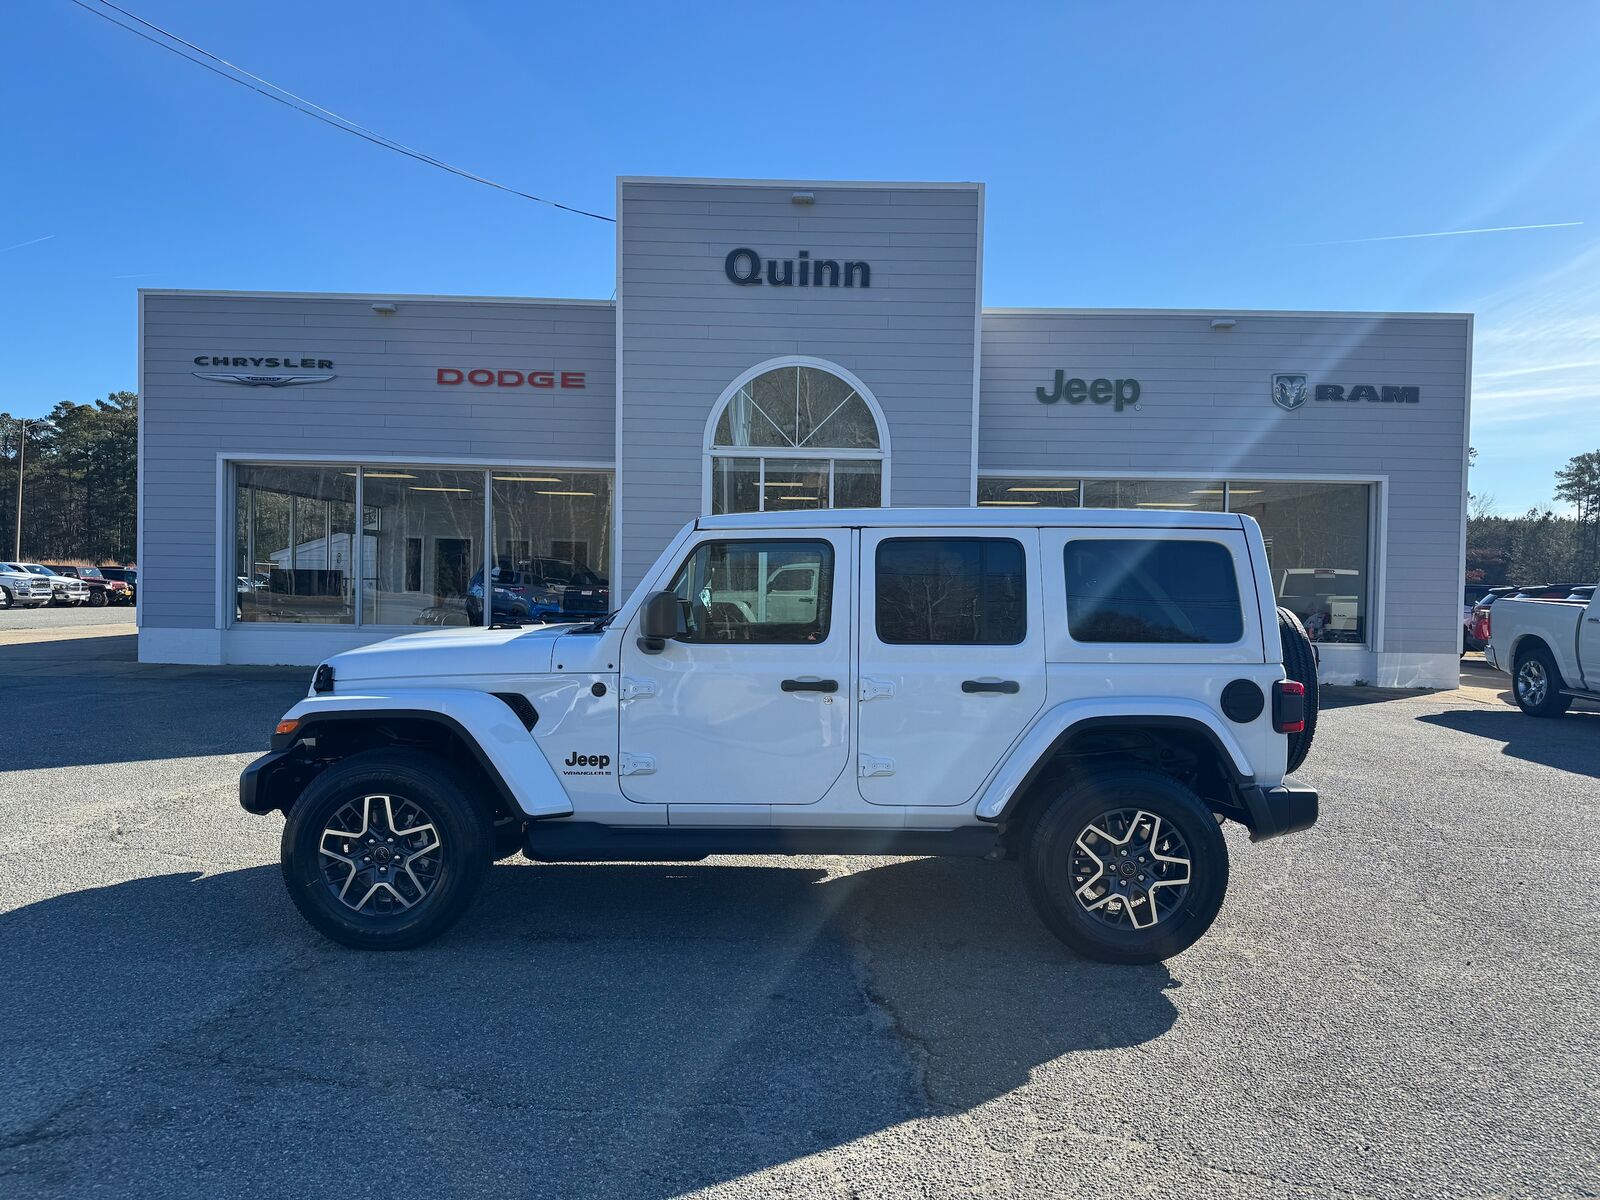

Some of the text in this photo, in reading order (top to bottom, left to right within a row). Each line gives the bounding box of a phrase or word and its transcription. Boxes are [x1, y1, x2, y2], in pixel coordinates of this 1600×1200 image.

[725, 247, 871, 288] Quinn
[193, 355, 334, 369] CHRYSLER
[436, 368, 586, 389] DODGE
[1036, 369, 1140, 412] Jeep
[1315, 384, 1420, 403] RAM
[565, 751, 610, 769] Jeep
